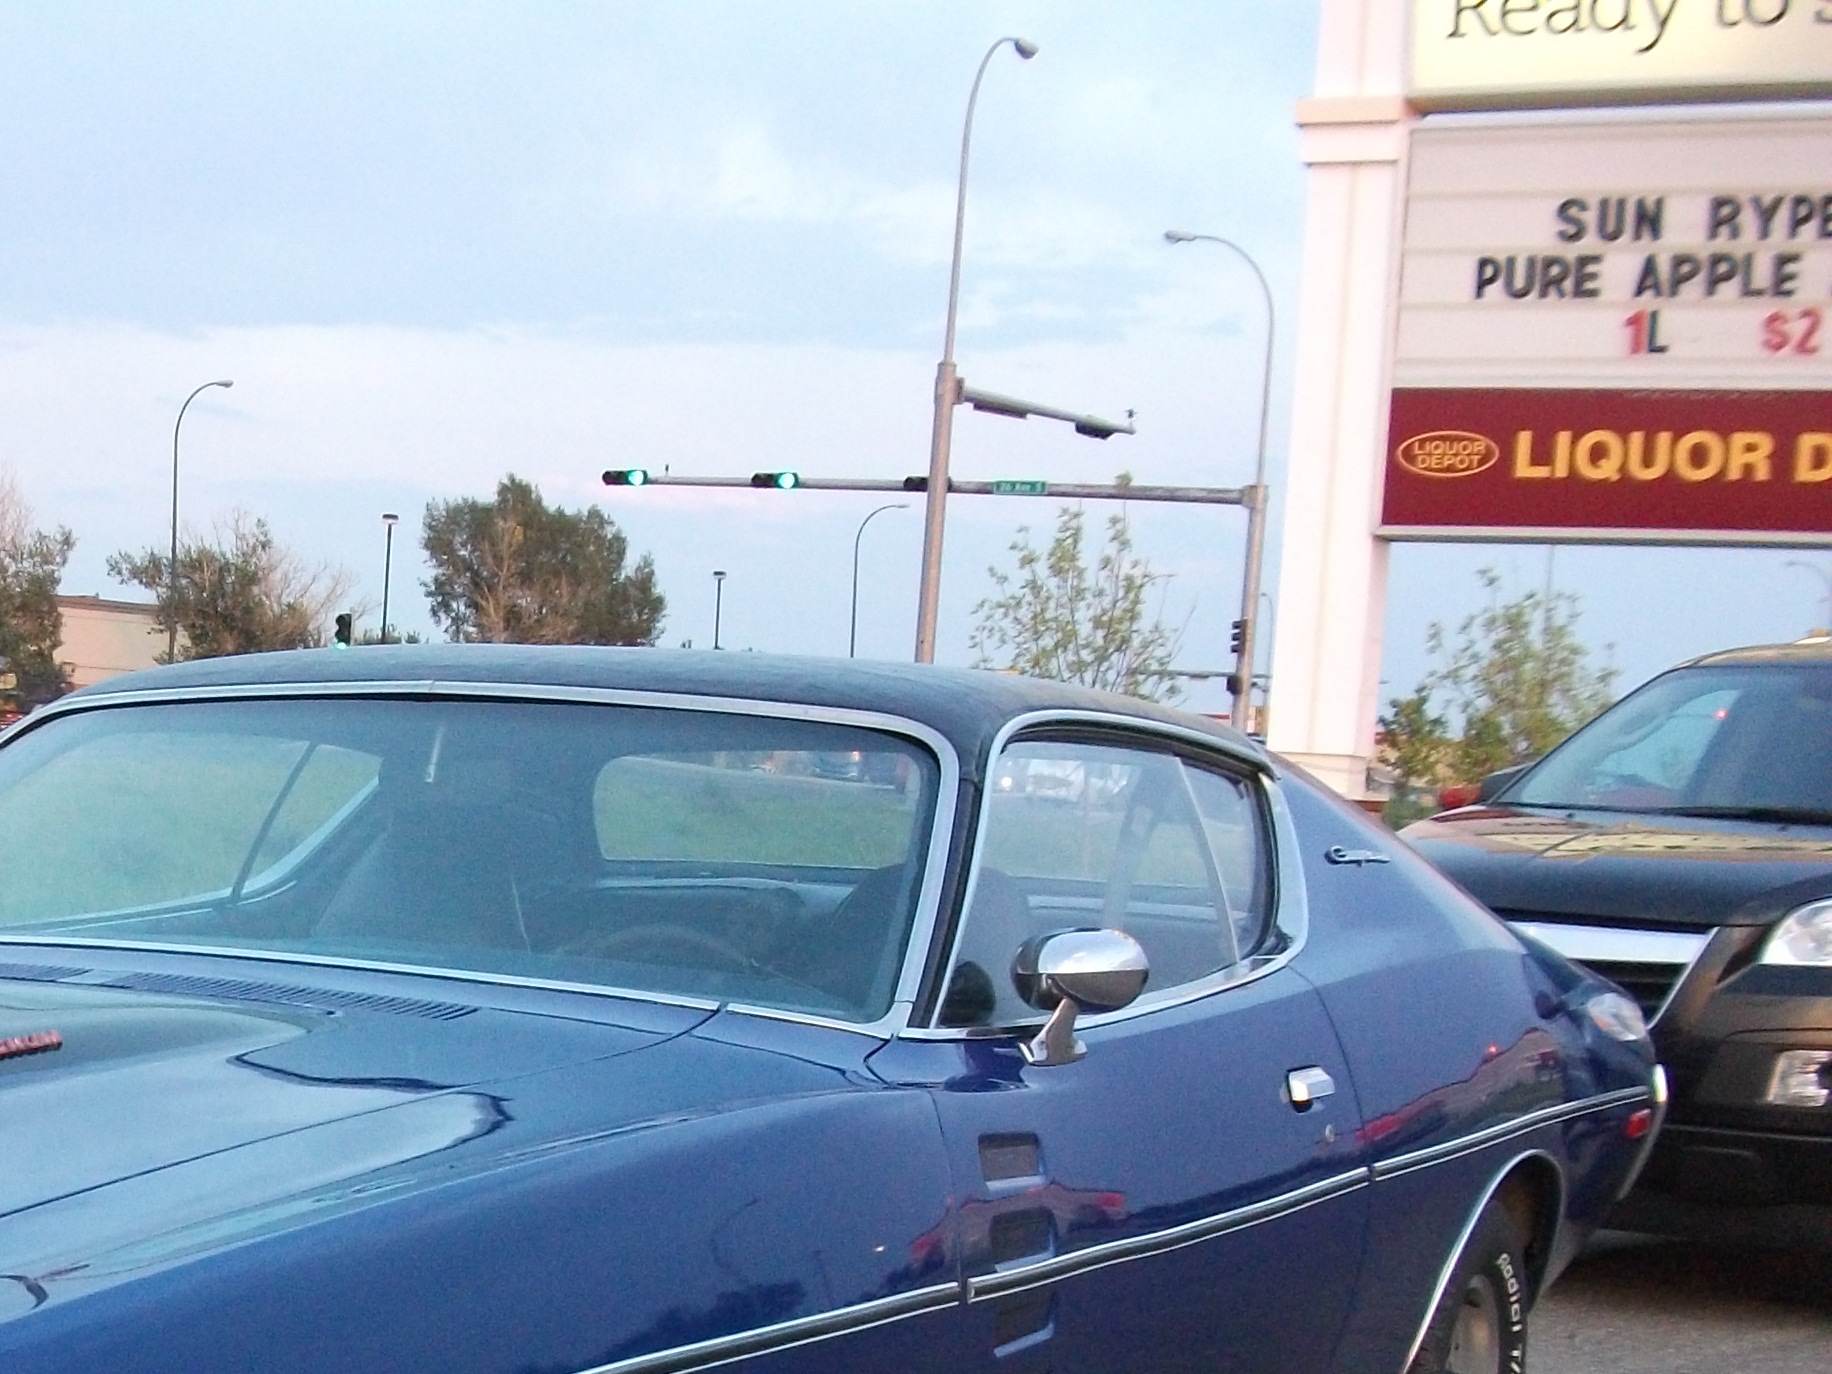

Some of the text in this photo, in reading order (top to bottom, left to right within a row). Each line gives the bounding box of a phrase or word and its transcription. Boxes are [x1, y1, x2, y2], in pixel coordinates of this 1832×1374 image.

[1556, 197, 1664, 242] SUN
[1474, 252, 1802, 299] PURE APPLE
[1624, 309, 1670, 355] 1L
[1414, 441, 1486, 454] LIQUOR
[1417, 455, 1483, 468] DEPOT
[1514, 429, 1775, 482] LIQUOR
